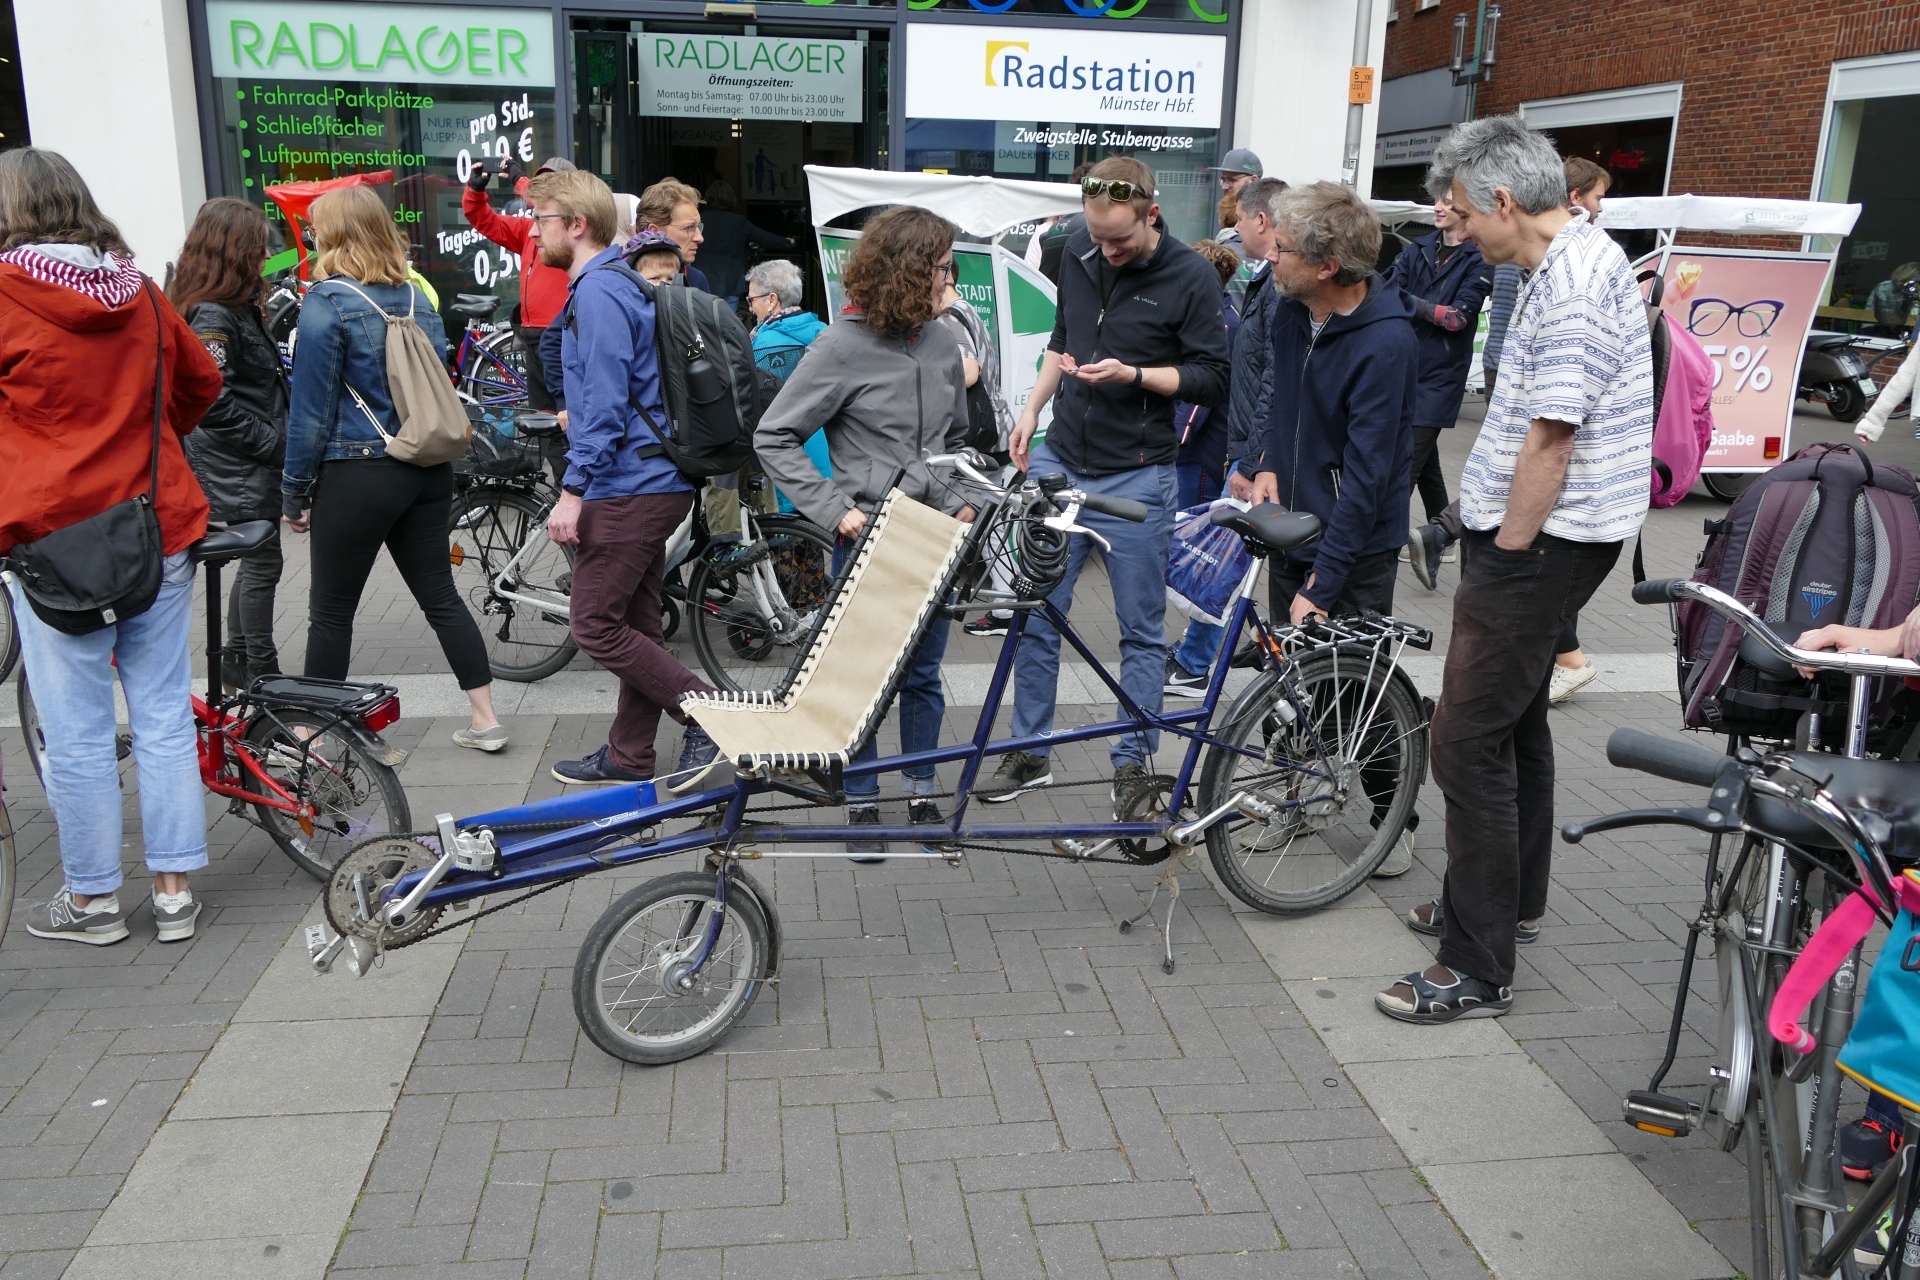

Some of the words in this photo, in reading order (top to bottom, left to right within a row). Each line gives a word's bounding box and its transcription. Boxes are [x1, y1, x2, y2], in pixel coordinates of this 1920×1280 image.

[230, 19, 528, 75] RADLAGER
[655, 38, 845, 74] RADLAGER
[708, 74, 794, 89] Öffnungszeiten:
[1003, 55, 1195, 94] Radstation
[1354, 71, 1359, 80] 5
[252, 85, 434, 113] Fahrrad-Parkplätze
[656, 89, 690, 101] Montag
[691, 90, 704, 100] bis
[705, 90, 744, 102] Samstag:
[749, 93, 772, 102] 07.00
[774, 93, 790, 102] Uhr
[791, 93, 803, 103] bis
[805, 95, 828, 104] 23.00
[829, 95, 845, 104] Uhr
[1100, 95, 1160, 112] Münster
[1165, 97, 1194, 113] Hbf.
[470, 113, 497, 145] pro
[501, 93, 534, 127] Std.
[657, 103, 682, 112] Sonn-
[684, 103, 700, 113] und
[702, 104, 744, 115] Feiertage:
[750, 106, 772, 115] 10.00
[774, 106, 790, 115] Uhr
[791, 106, 803, 116] bis
[805, 107, 828, 117] 23.00
[829, 108, 845, 117] Uhr
[256, 114, 384, 137] Schließfächer
[427, 117, 452, 128] NUR
[456, 116, 471, 129] FÜ
[1013, 127, 1097, 148] Zweigstelle
[1100, 130, 1193, 152] Stubengasse
[259, 143, 426, 170] Luftpumpenstation
[1702, 345, 1772, 391] 5%
[1180, 540, 1219, 566] KARSTADT
[1801, 585, 1837, 596] airstripes
[1809, 581, 1832, 589] deuter
